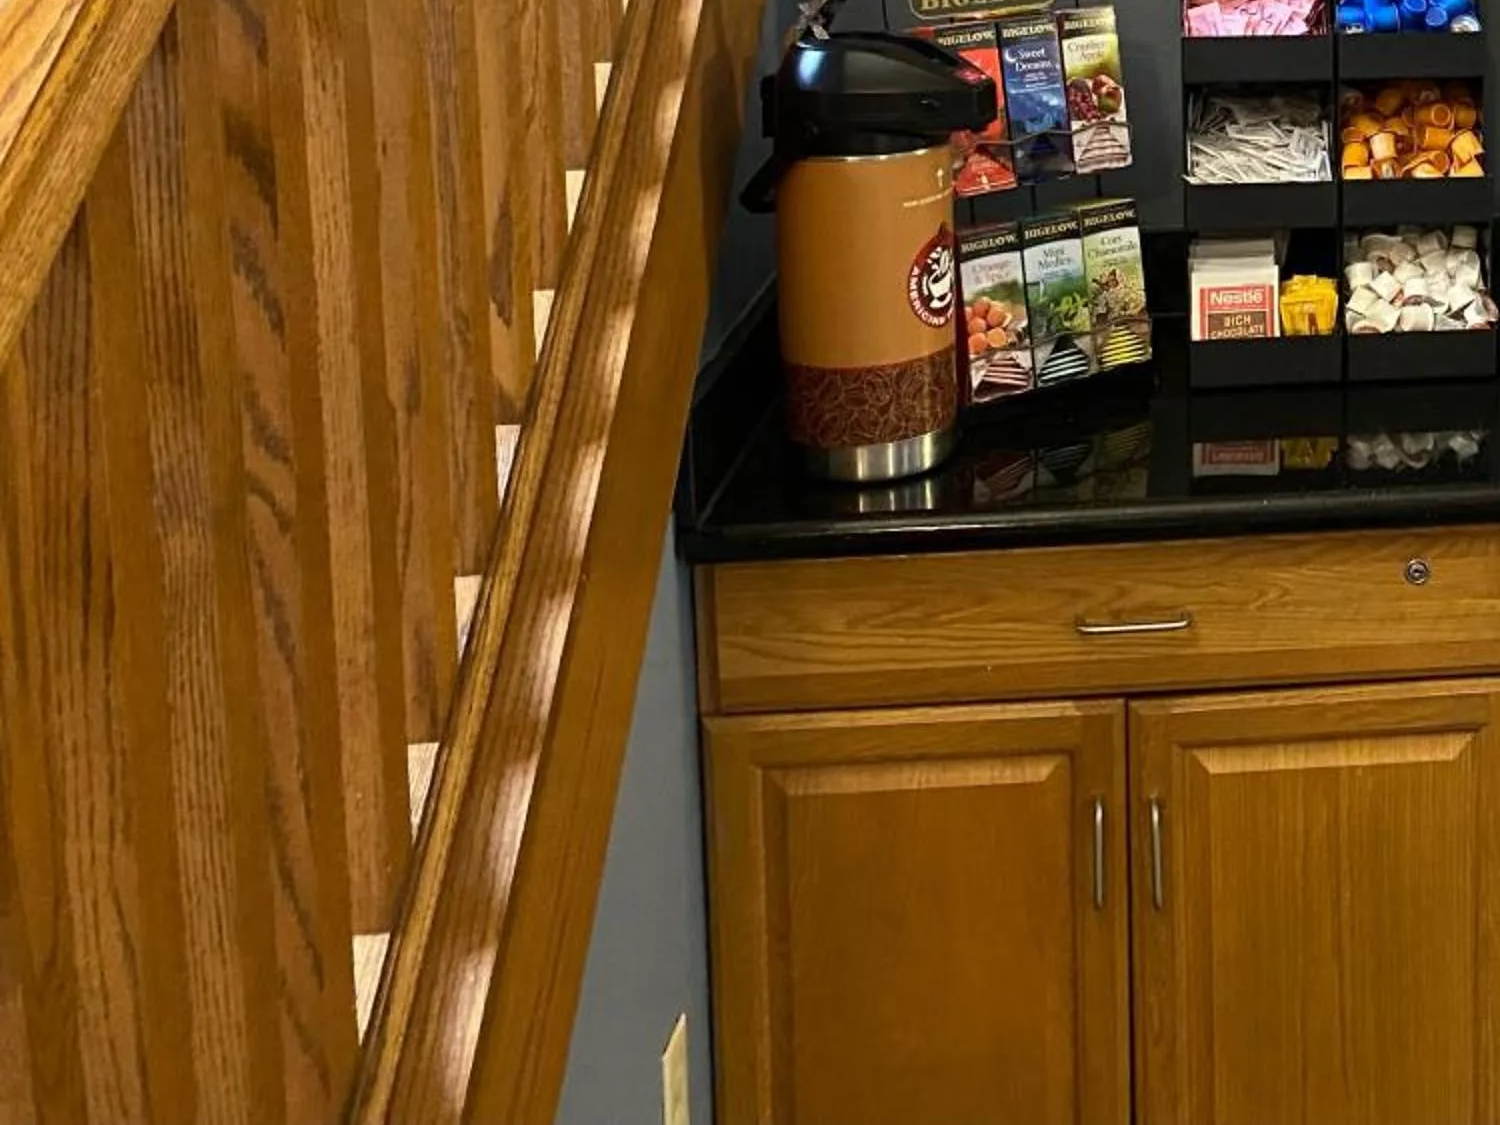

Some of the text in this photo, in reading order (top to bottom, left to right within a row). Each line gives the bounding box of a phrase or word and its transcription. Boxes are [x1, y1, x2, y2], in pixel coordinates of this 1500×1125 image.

[1002, 22, 1055, 38] BIGELOW
[1084, 209, 1136, 227] BIGELOW
[1024, 220, 1079, 240] BIGELOW
[960, 233, 1017, 253] BIGELOW
[1223, 314, 1251, 328] RICH
